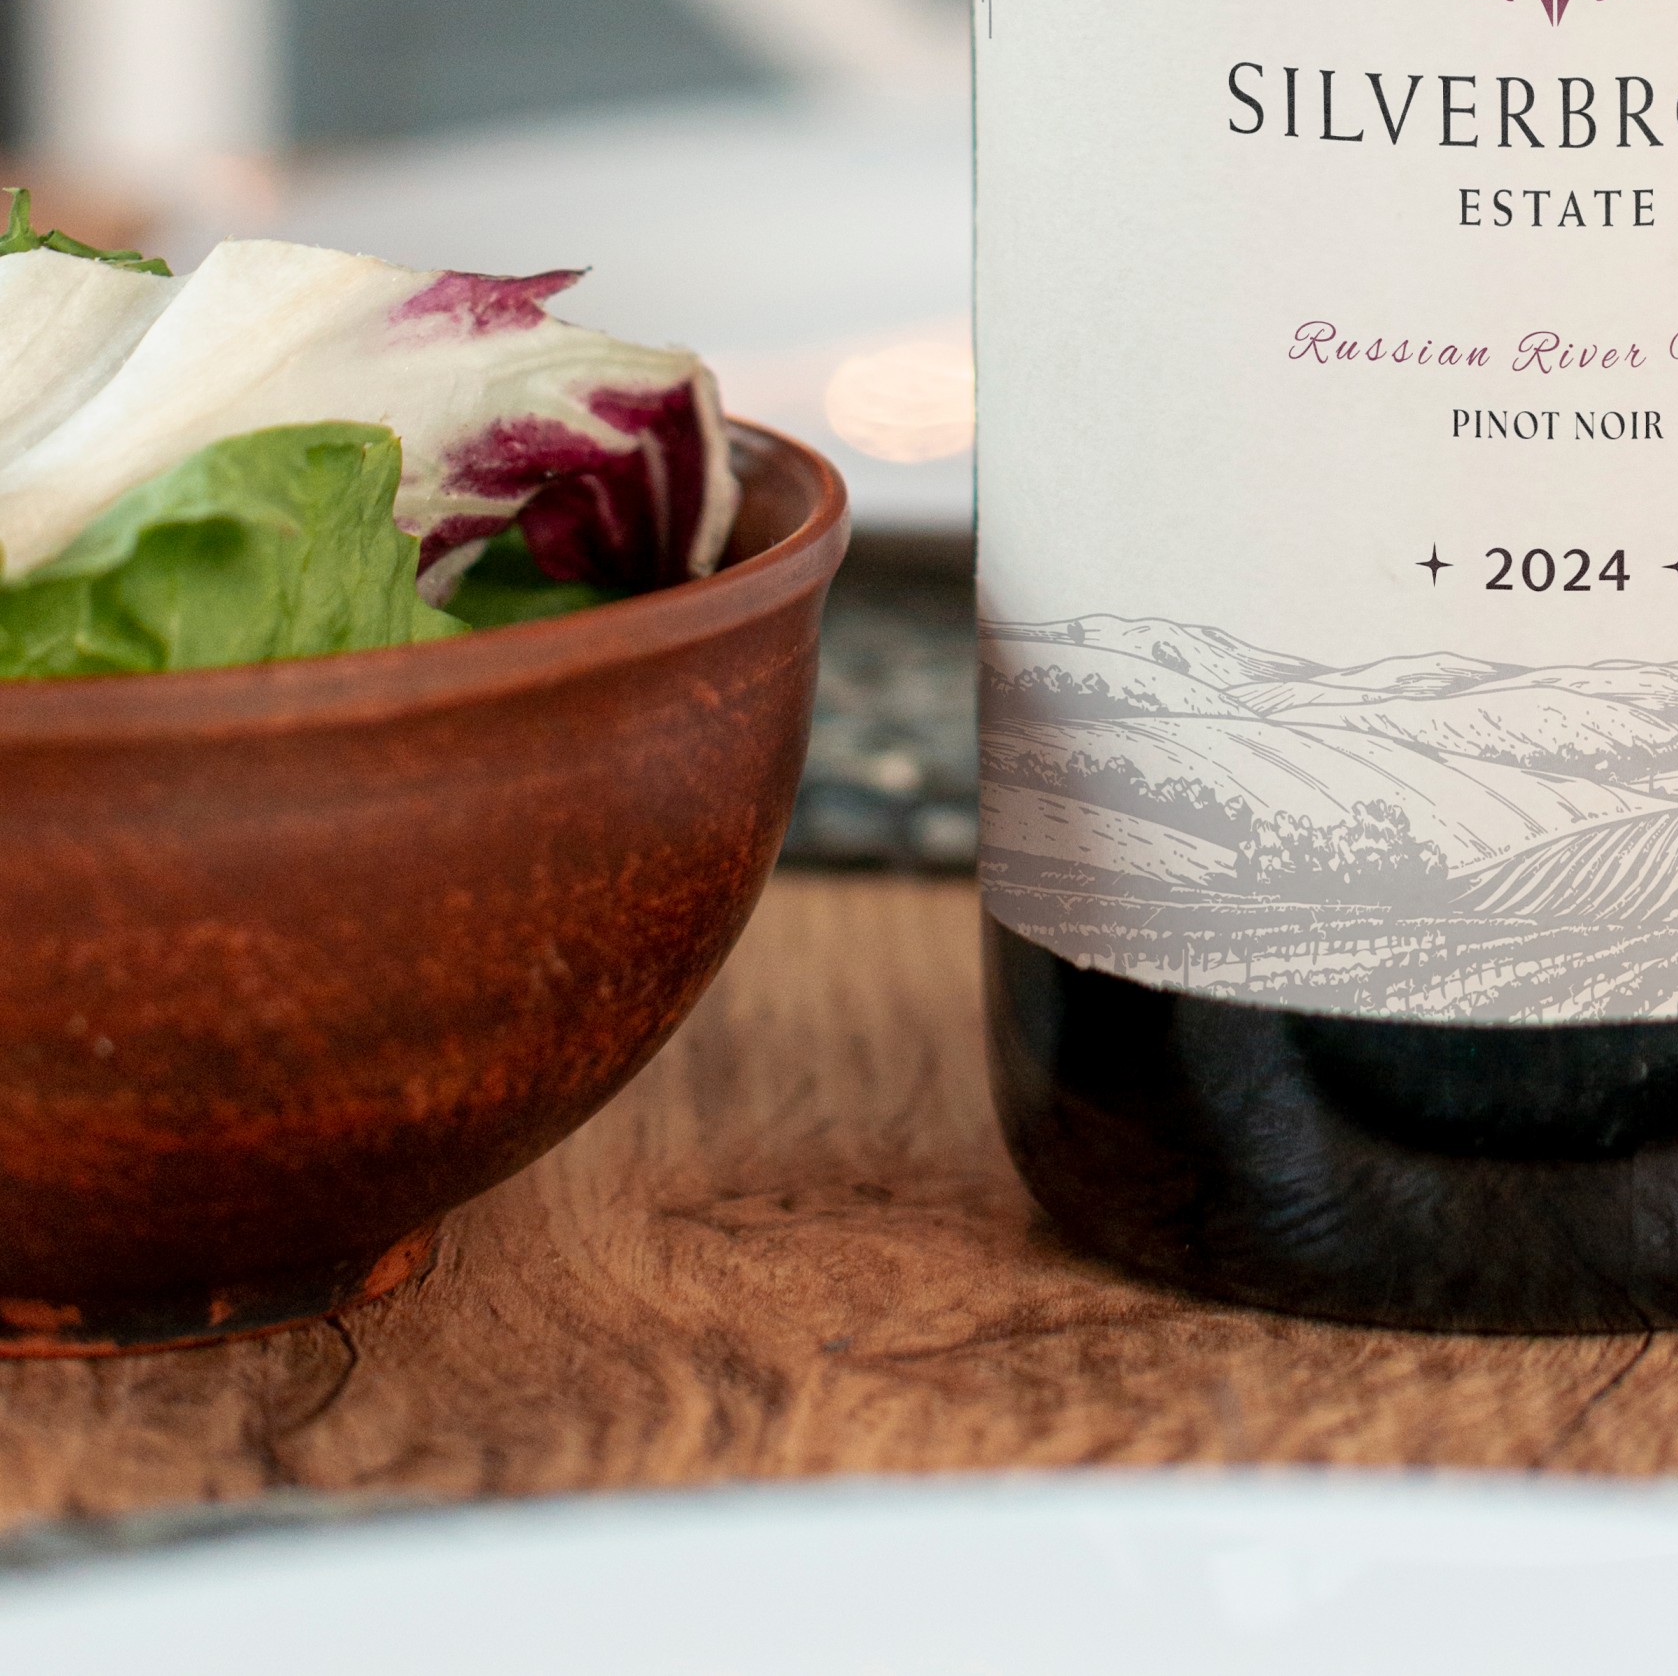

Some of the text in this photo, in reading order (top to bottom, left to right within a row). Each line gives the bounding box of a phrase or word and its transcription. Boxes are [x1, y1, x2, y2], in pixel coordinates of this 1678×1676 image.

[1457, 187, 1657, 229] ESTATE
[1287, 319, 1492, 368] Russian
[1510, 329, 1648, 374] River
[1450, 409, 1666, 442] PINOT NOIR
[1483, 546, 1633, 593] 2024
